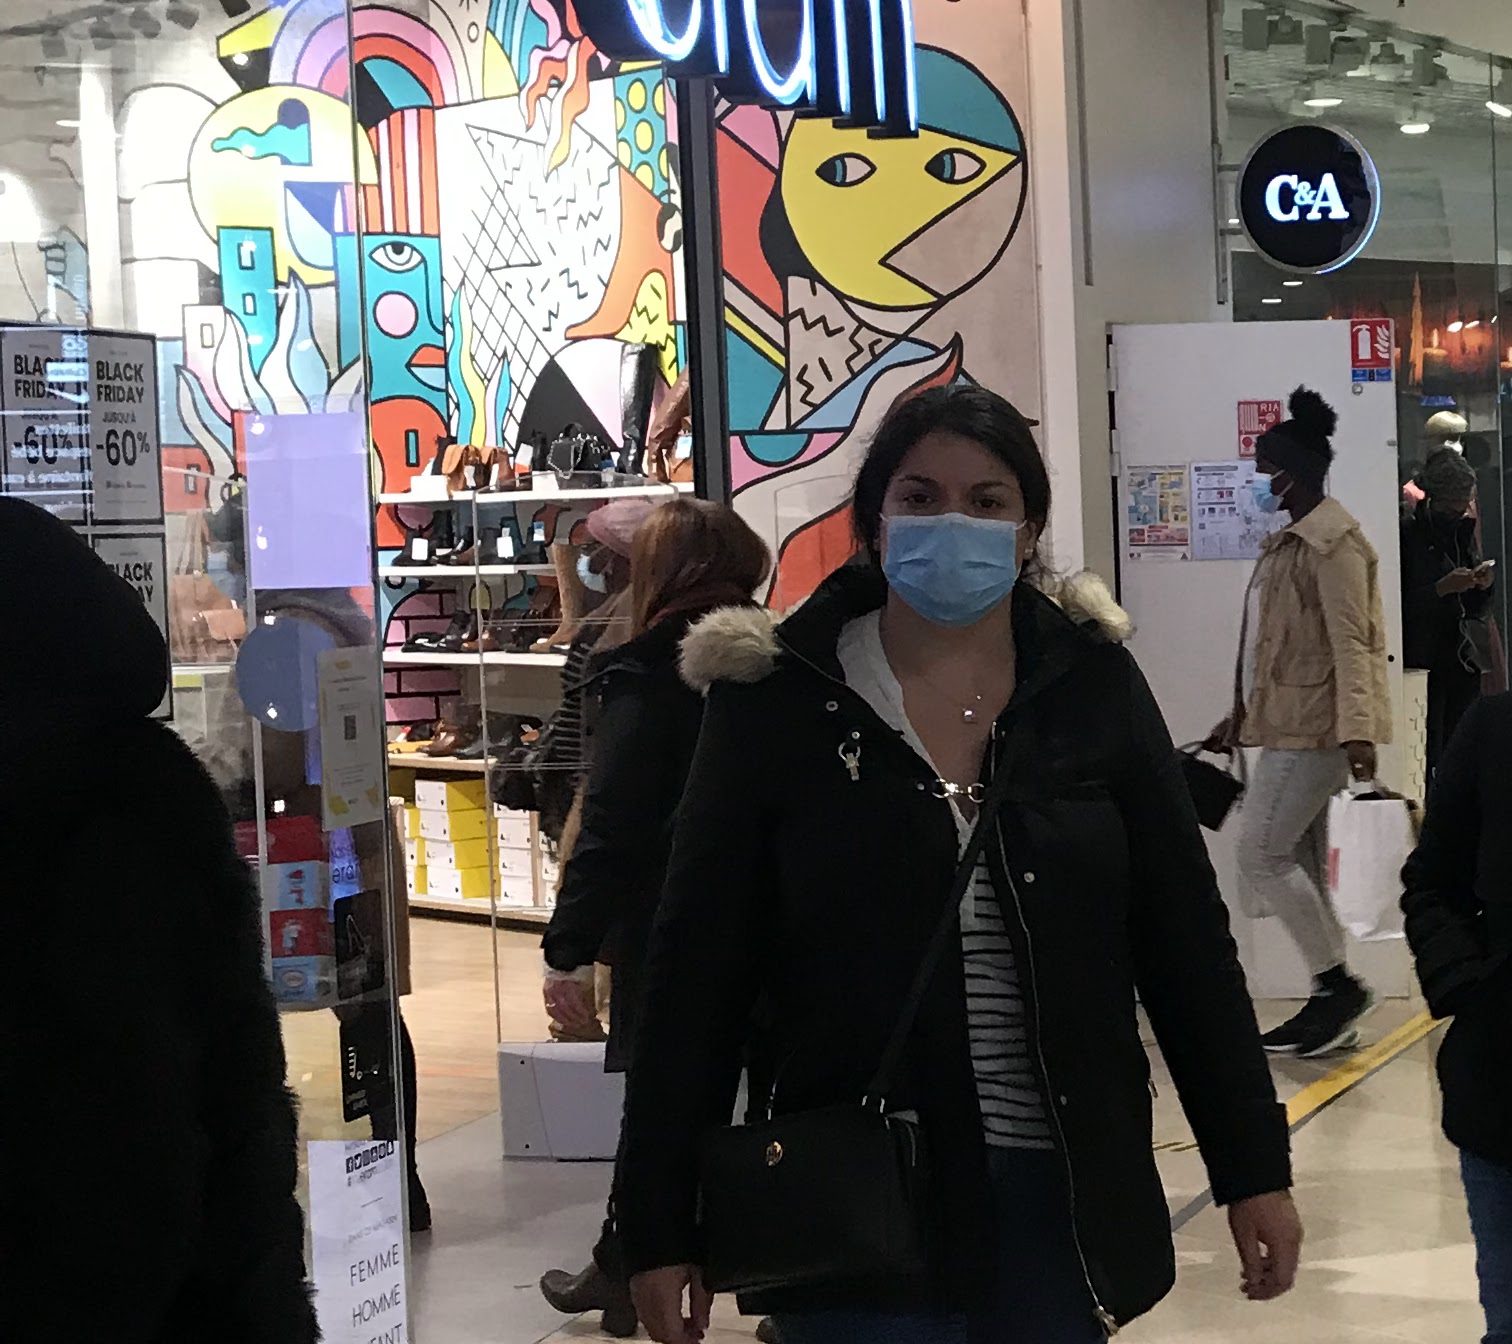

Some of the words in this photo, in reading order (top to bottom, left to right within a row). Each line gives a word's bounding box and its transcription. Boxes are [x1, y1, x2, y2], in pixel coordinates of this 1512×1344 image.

[1265, 172, 1350, 222] C&A
[96, 360, 144, 382] BLACK
[96, 383, 144, 403] FRIDAY
[1260, 403, 1279, 412] RIA
[96, 428, 150, 466] -60%
[107, 562, 153, 582] ACK
[350, 1243, 400, 1287] FEMME
[352, 1283, 401, 1328] HOMME
